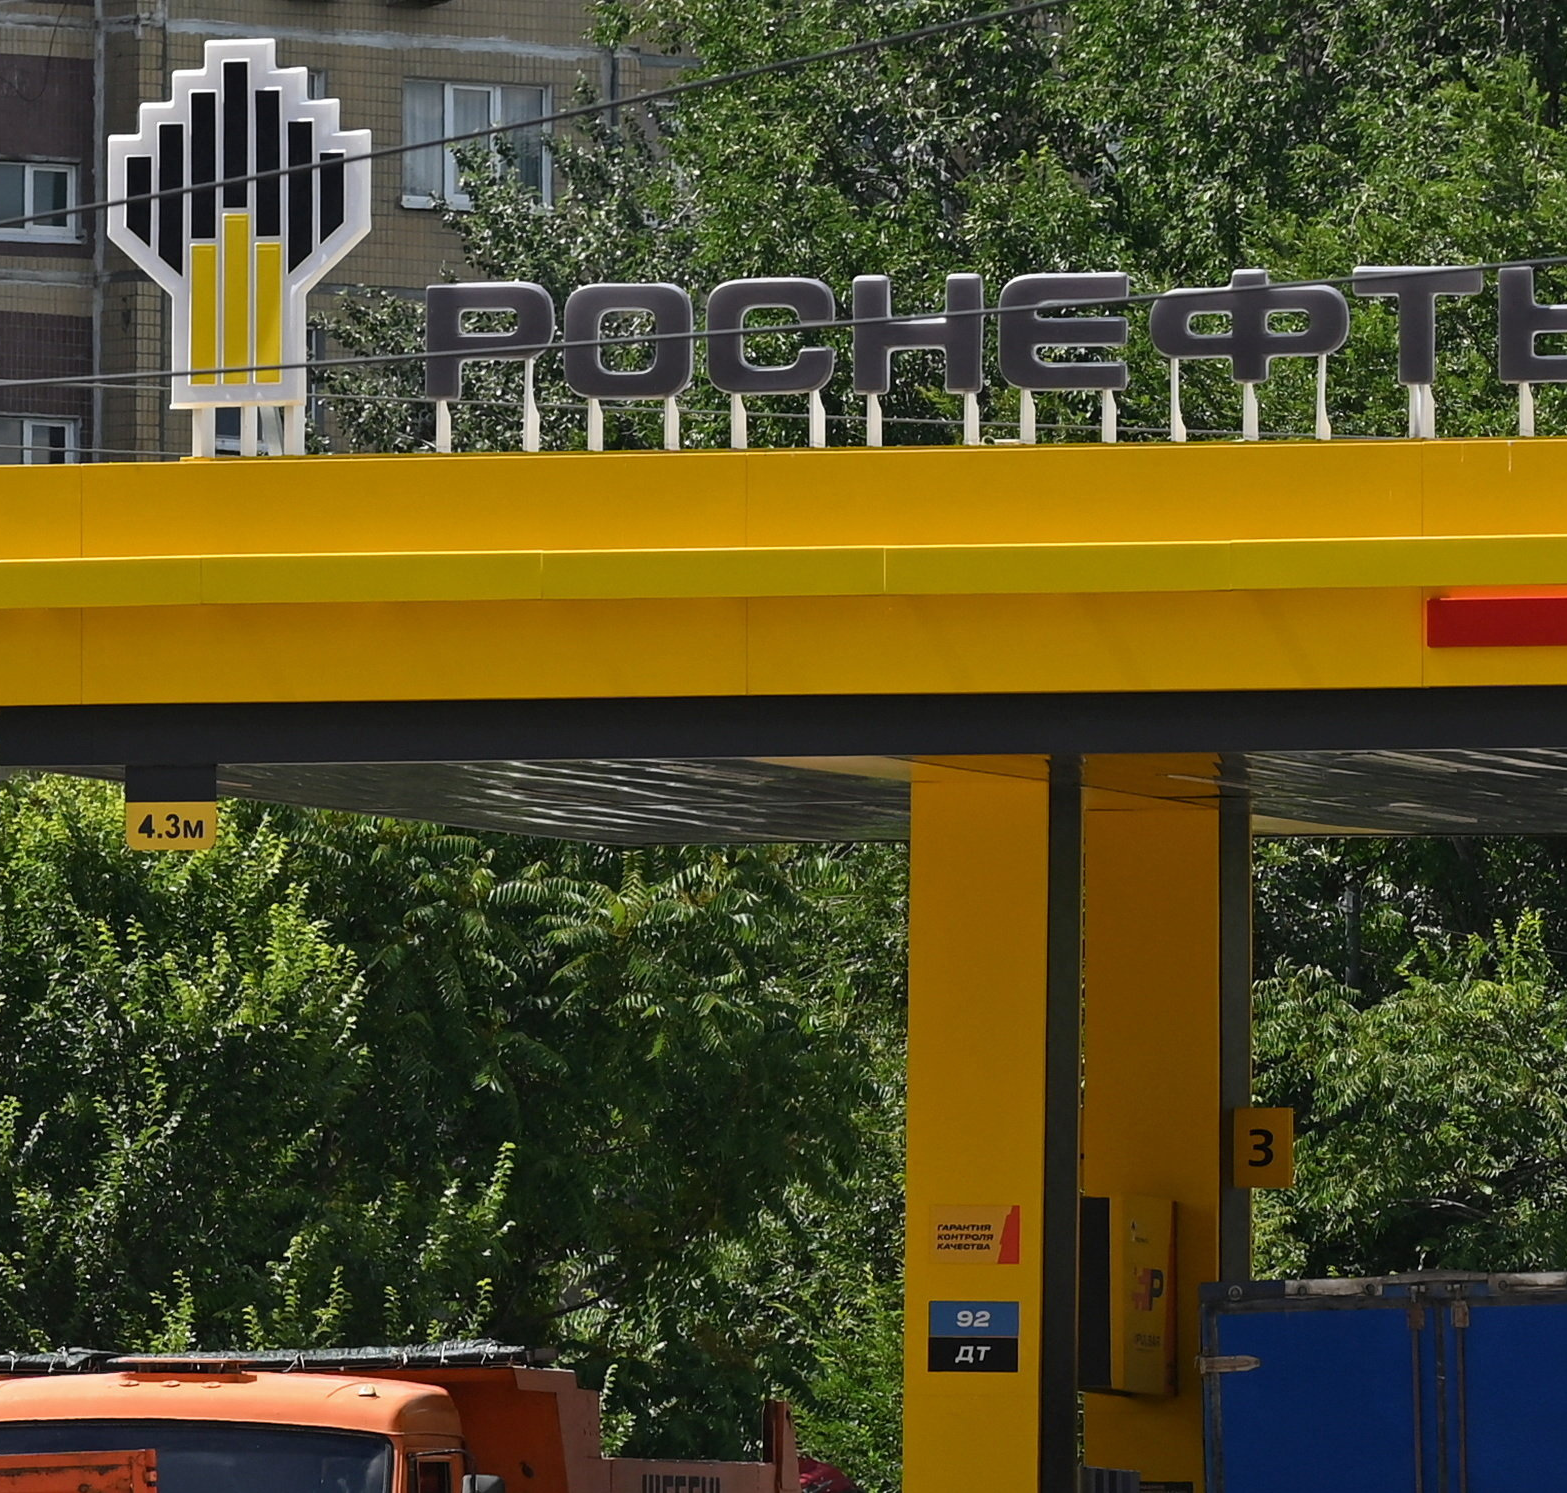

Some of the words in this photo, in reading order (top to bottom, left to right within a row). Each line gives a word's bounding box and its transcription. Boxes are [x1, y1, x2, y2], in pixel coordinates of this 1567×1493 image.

[1247, 1128, 1275, 1168] 3
[937, 1223, 992, 1232] ГАРАНТИЯ
[937, 1233, 994, 1242] КОНТРОЛЯ
[936, 1243, 991, 1251] КАЧЕСТВА
[956, 1310, 991, 1328] 92
[954, 1345, 992, 1364] ДТ
